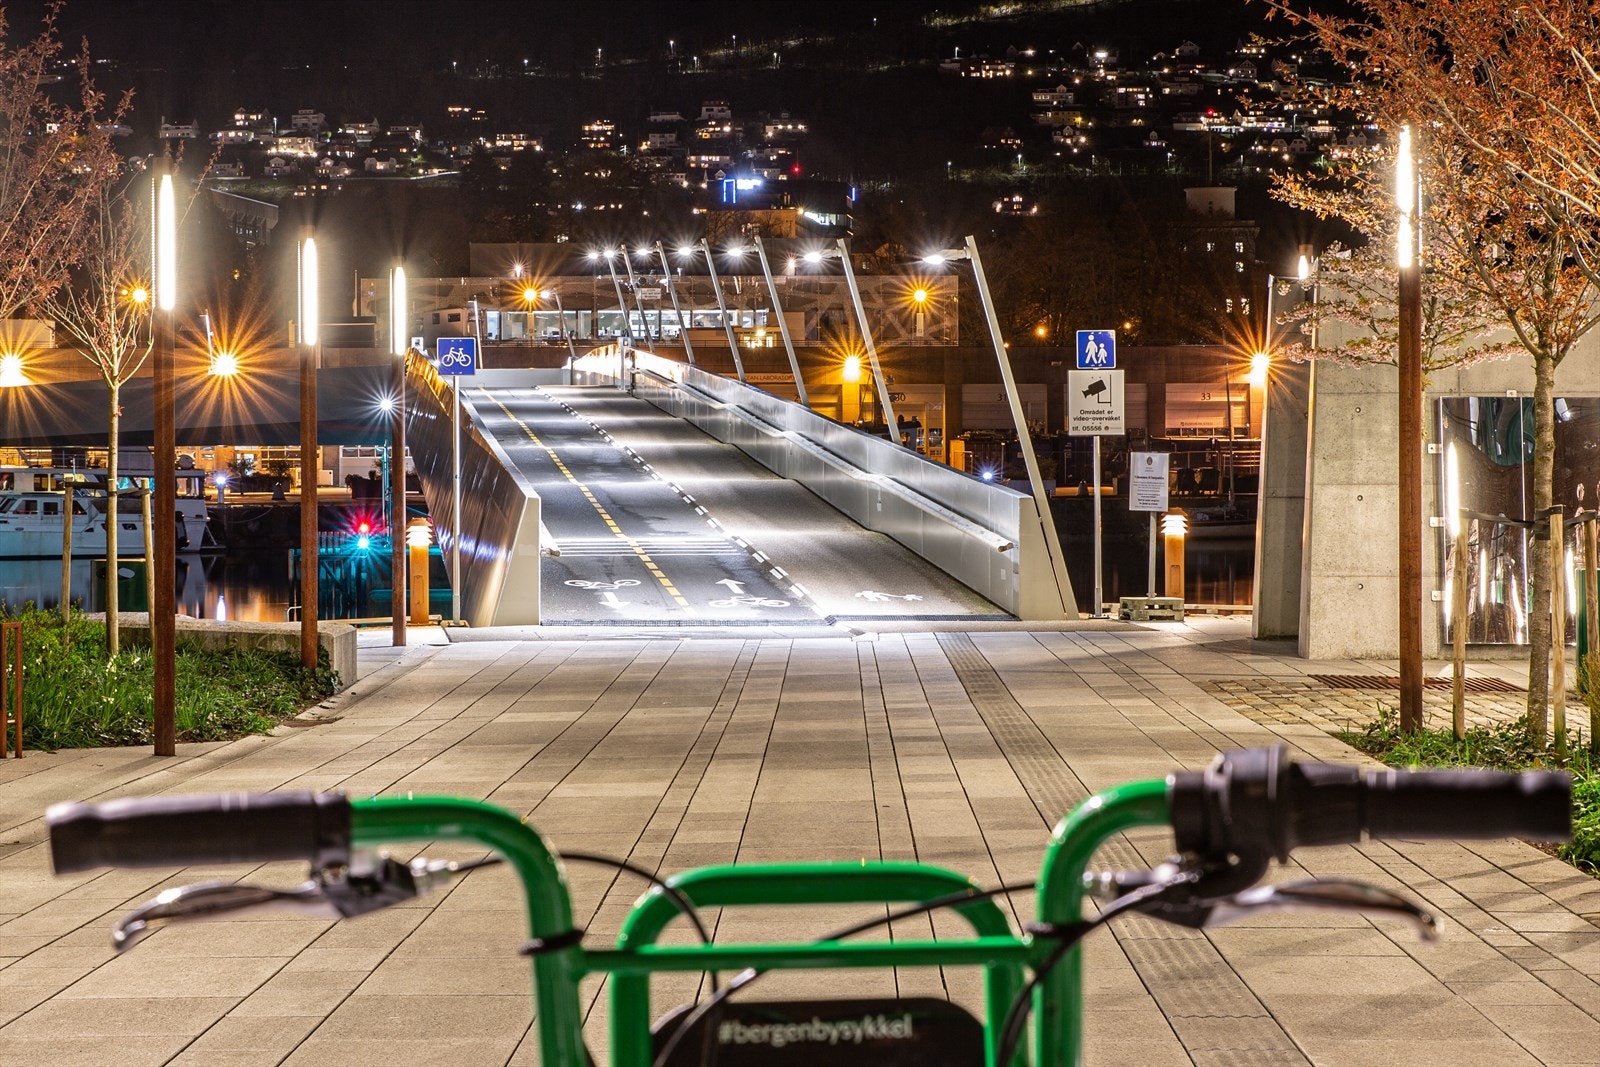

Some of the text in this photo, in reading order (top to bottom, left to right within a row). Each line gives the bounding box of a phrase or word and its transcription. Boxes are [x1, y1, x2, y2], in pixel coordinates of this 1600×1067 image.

[895, 392, 906, 402] 30
[1200, 392, 1211, 401] 33
[718, 1013, 913, 1048] #bergenbysykkel
